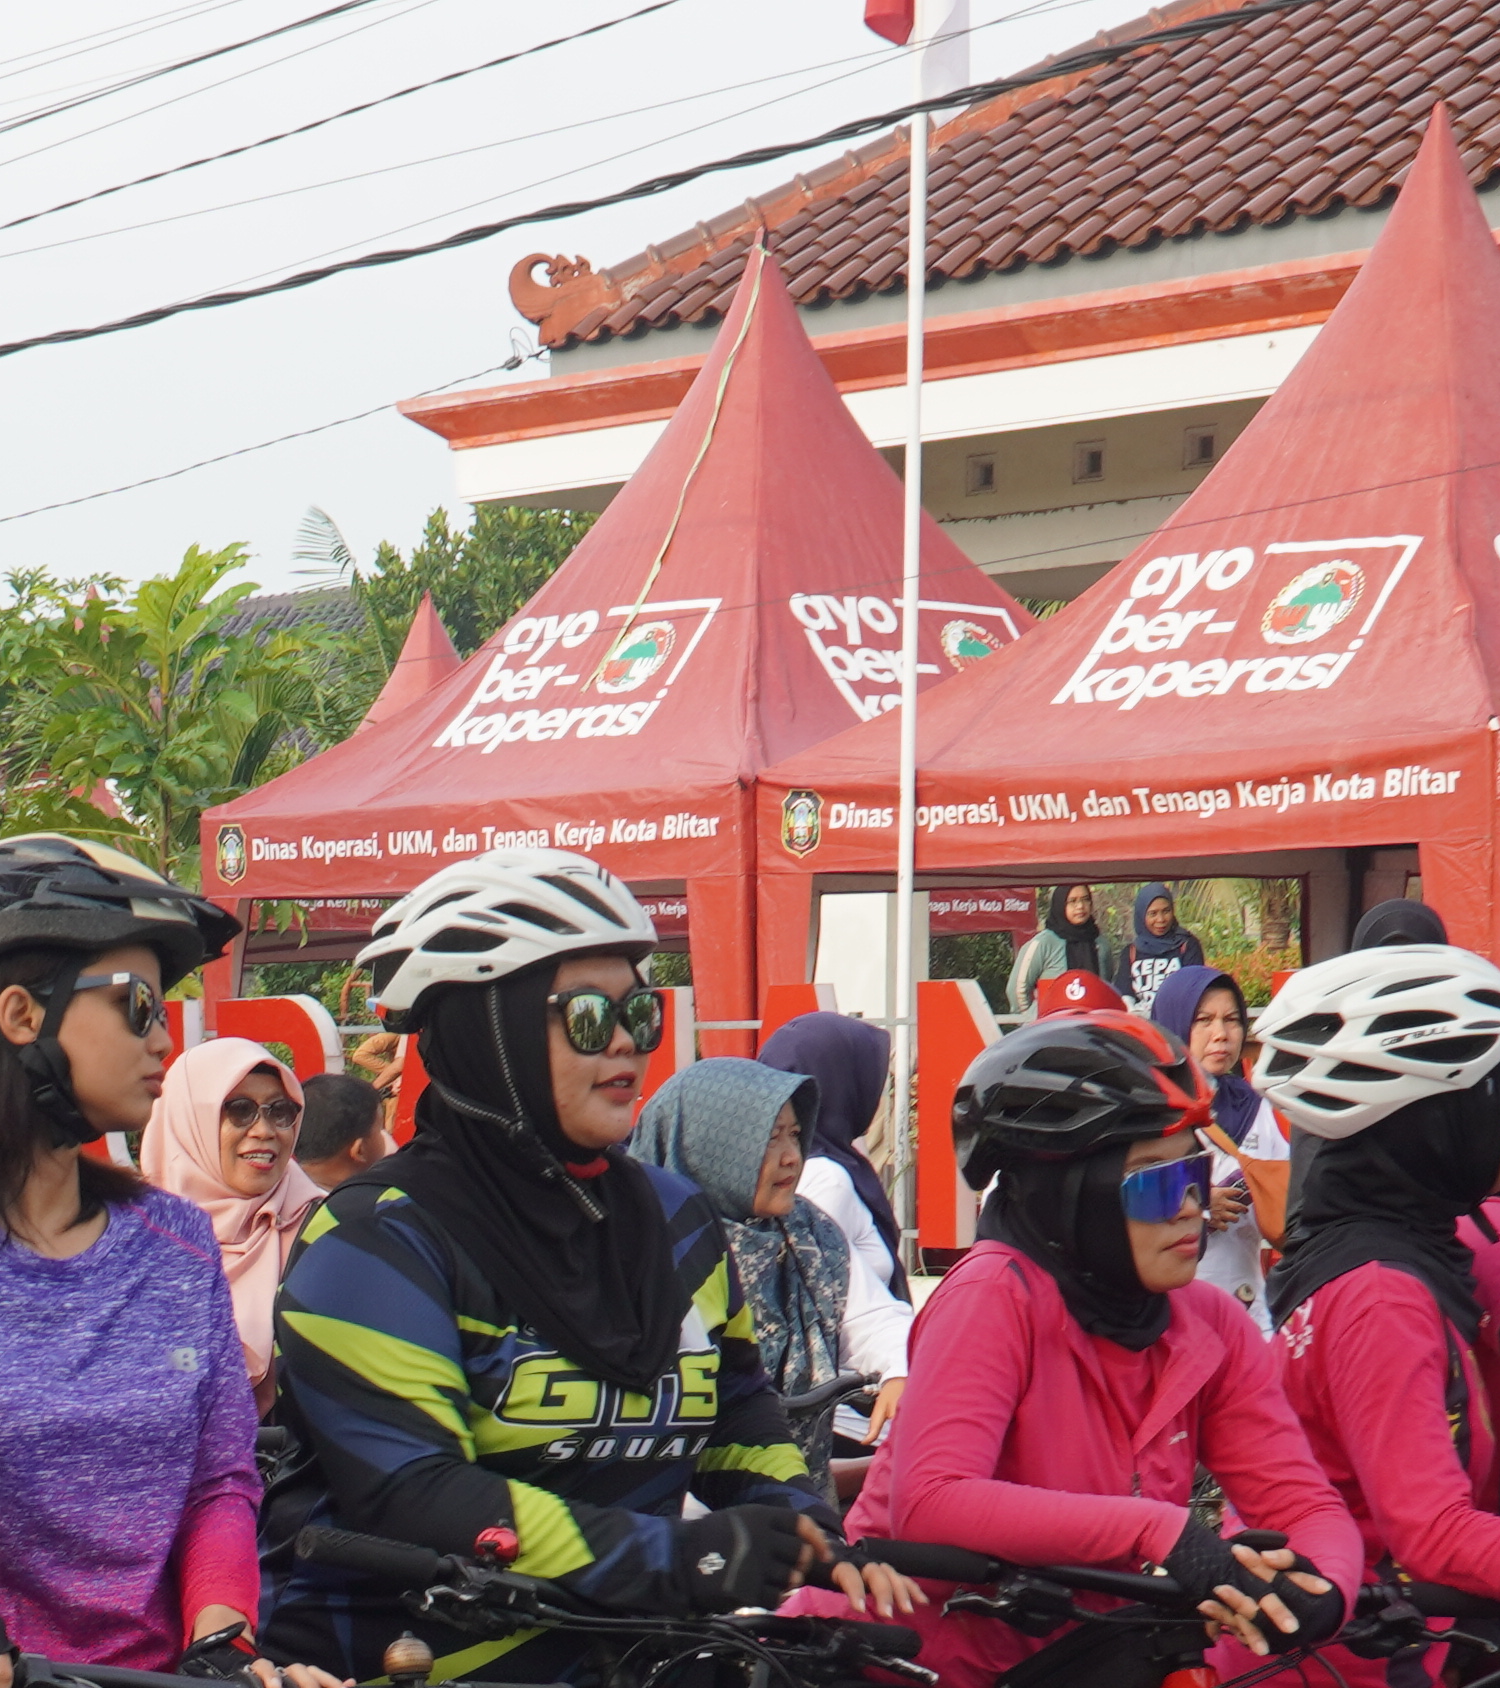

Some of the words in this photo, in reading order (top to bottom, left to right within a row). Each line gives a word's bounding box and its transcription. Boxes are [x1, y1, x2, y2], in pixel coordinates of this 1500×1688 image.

[1129, 545, 1256, 611] ayo
[502, 608, 601, 666] ayo
[789, 591, 899, 646] ayo
[1089, 596, 1238, 655] ber-
[468, 652, 581, 704] ber-
[1049, 637, 1365, 711] koperasi
[431, 686, 670, 755] koperasi
[828, 802, 895, 831] Dinas
[908, 795, 1006, 834] operasi,
[1008, 791, 1078, 824] UKM,
[1082, 787, 1132, 820] dan
[1139, 785, 1232, 820] Tenaga
[1236, 778, 1307, 817] Kerja
[1311, 773, 1377, 804] Kota
[1381, 766, 1462, 800] Blitar
[250, 835, 299, 863] Dinas
[300, 831, 384, 871] Koperasi,
[387, 829, 439, 860] UKM,
[441, 827, 479, 856] dan
[481, 824, 551, 851] Tenaga
[552, 820, 607, 854] Kerja
[609, 816, 660, 844] Kota
[661, 810, 721, 841] Blitar
[951, 898, 978, 916] Kerja
[978, 898, 1002, 914] Kota
[1002, 897, 1030, 914] Blitar
[1130, 956, 1183, 978] KEPA
